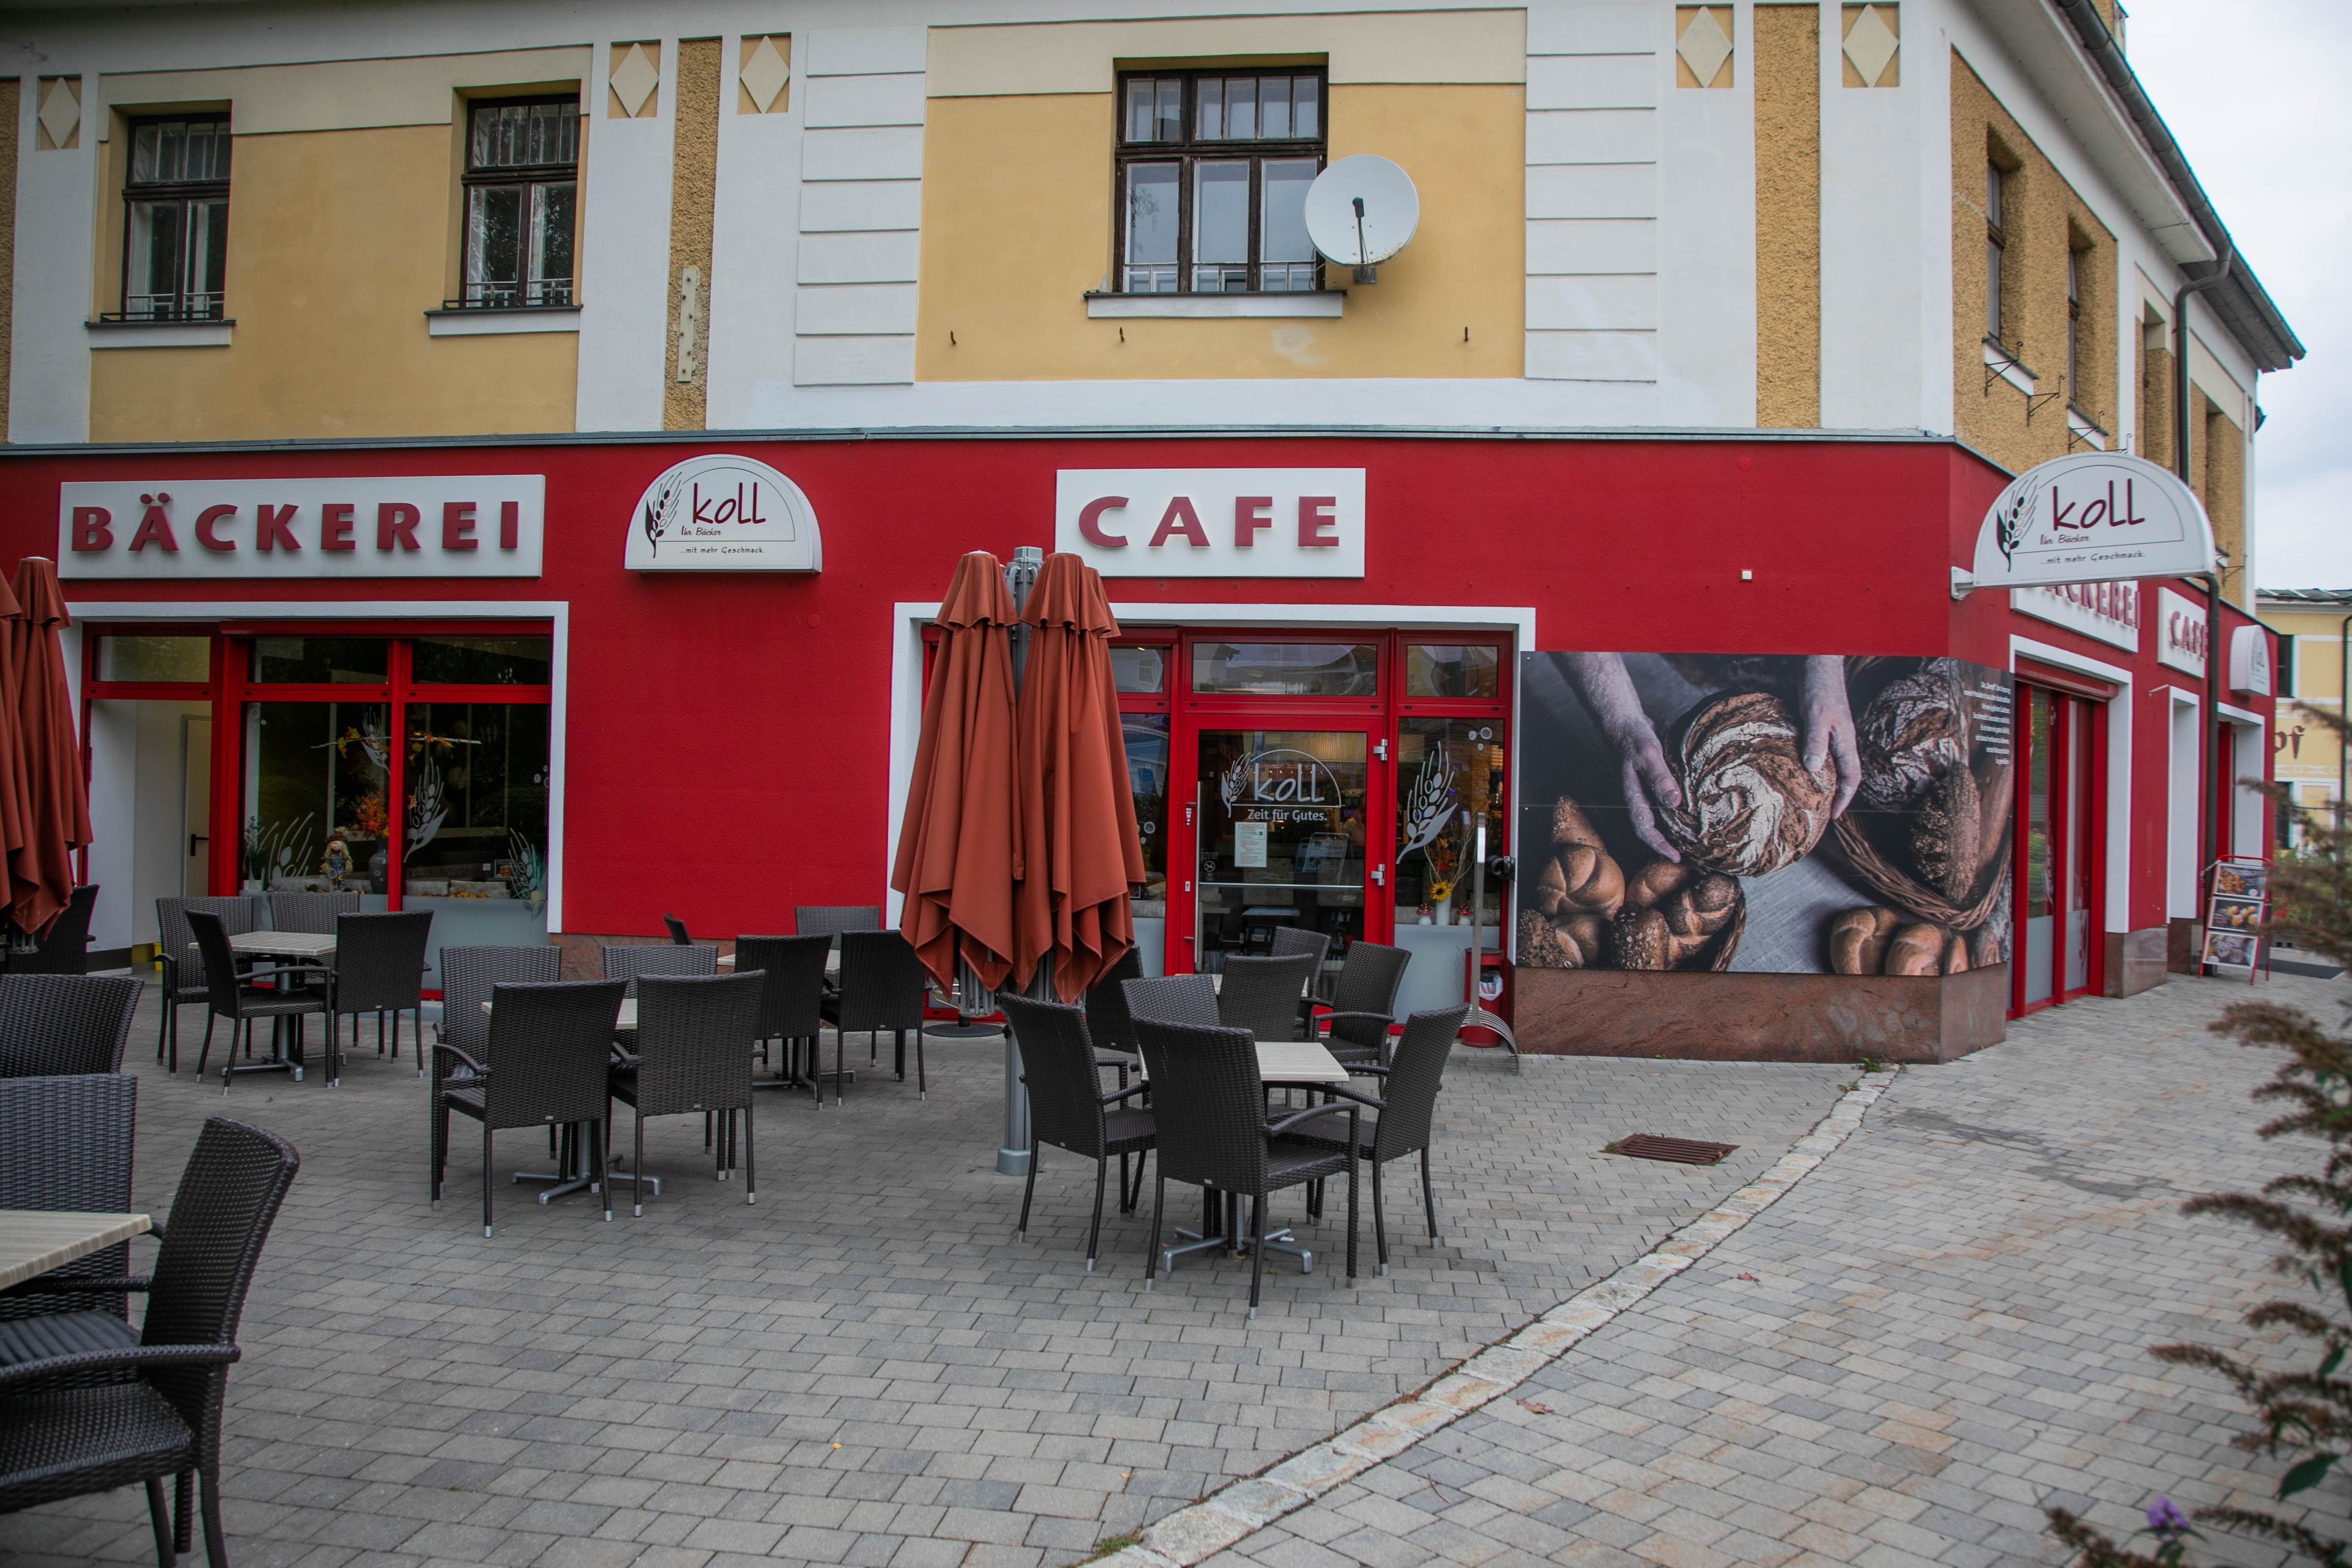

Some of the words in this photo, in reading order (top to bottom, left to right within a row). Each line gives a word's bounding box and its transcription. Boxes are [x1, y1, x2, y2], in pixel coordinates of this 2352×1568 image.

[71, 492, 519, 552] BÄCKEREI
[1079, 496, 1339, 548] CAFE
[681, 526, 692, 536] Ihr
[696, 527, 721, 536] Bäcker
[2058, 534, 2090, 544] Bäcker
[721, 546, 766, 555] Geschmack.
[2065, 555, 2086, 563] mehr
[2170, 610, 2209, 658] CAFE
[1247, 809, 1269, 820] Zeit
[1272, 809, 1290, 821] für
[1292, 810, 1327, 823] Gutes.
